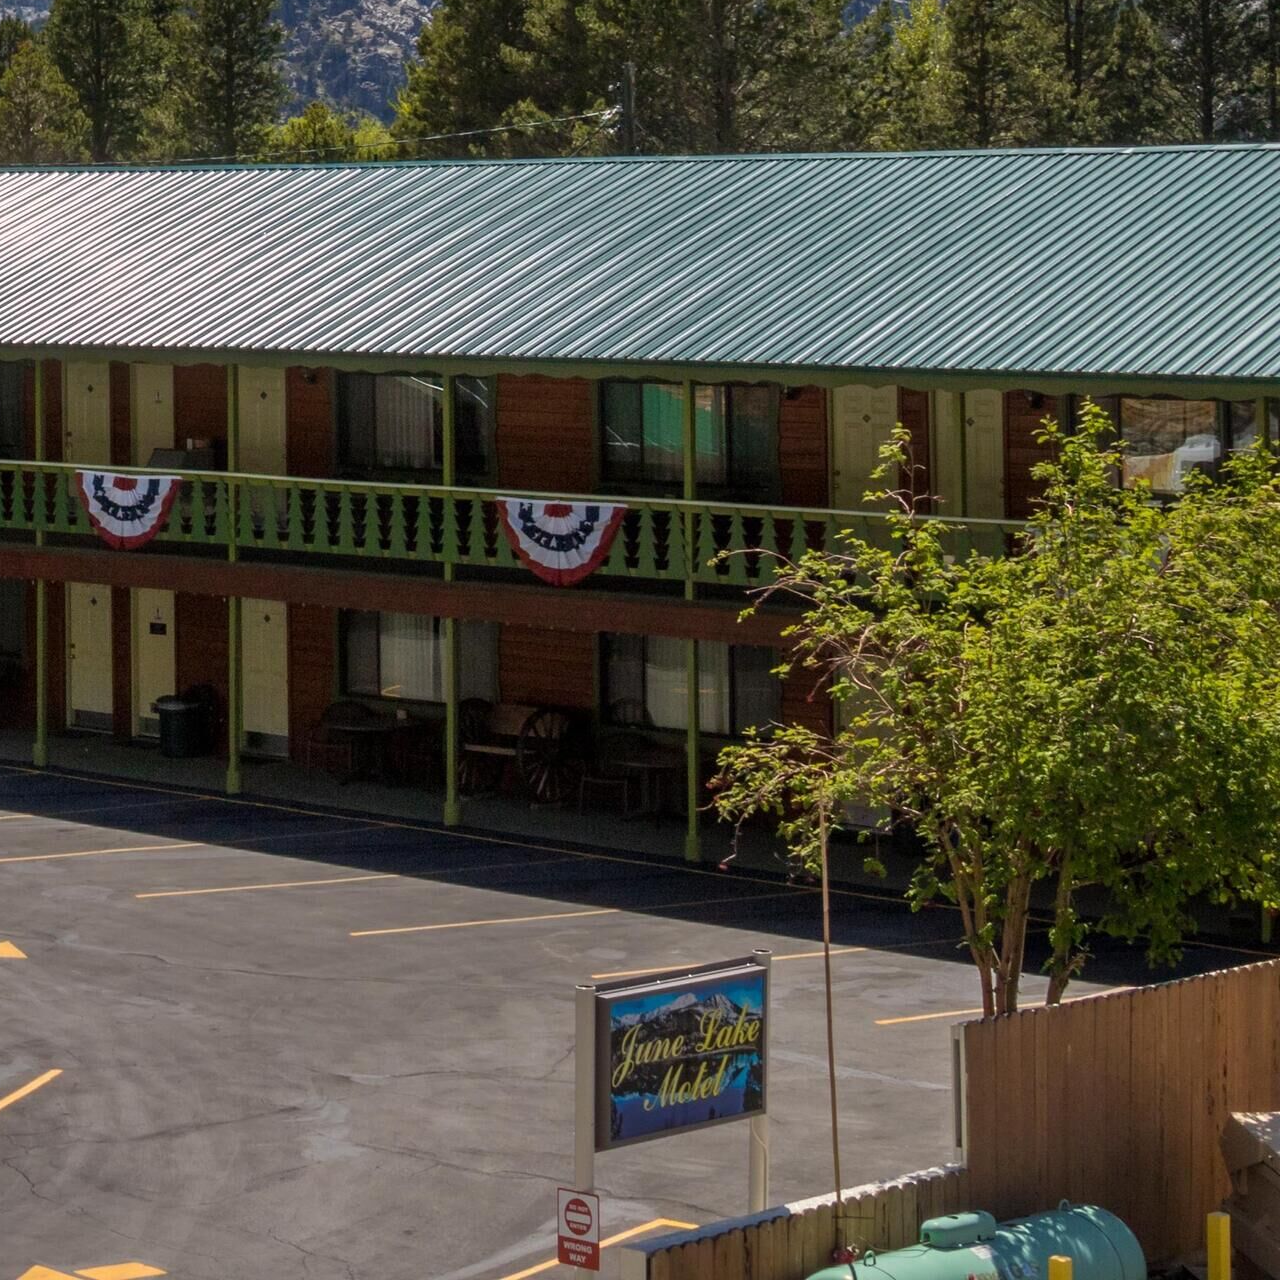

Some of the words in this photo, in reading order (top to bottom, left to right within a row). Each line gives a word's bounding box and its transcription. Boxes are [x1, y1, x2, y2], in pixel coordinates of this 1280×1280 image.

[612, 1024, 685, 1088] June
[695, 1003, 760, 1052] Lake
[643, 1055, 729, 1111] Motel
[563, 1240, 593, 1254] WRONG
[569, 1252, 587, 1263] WAY
